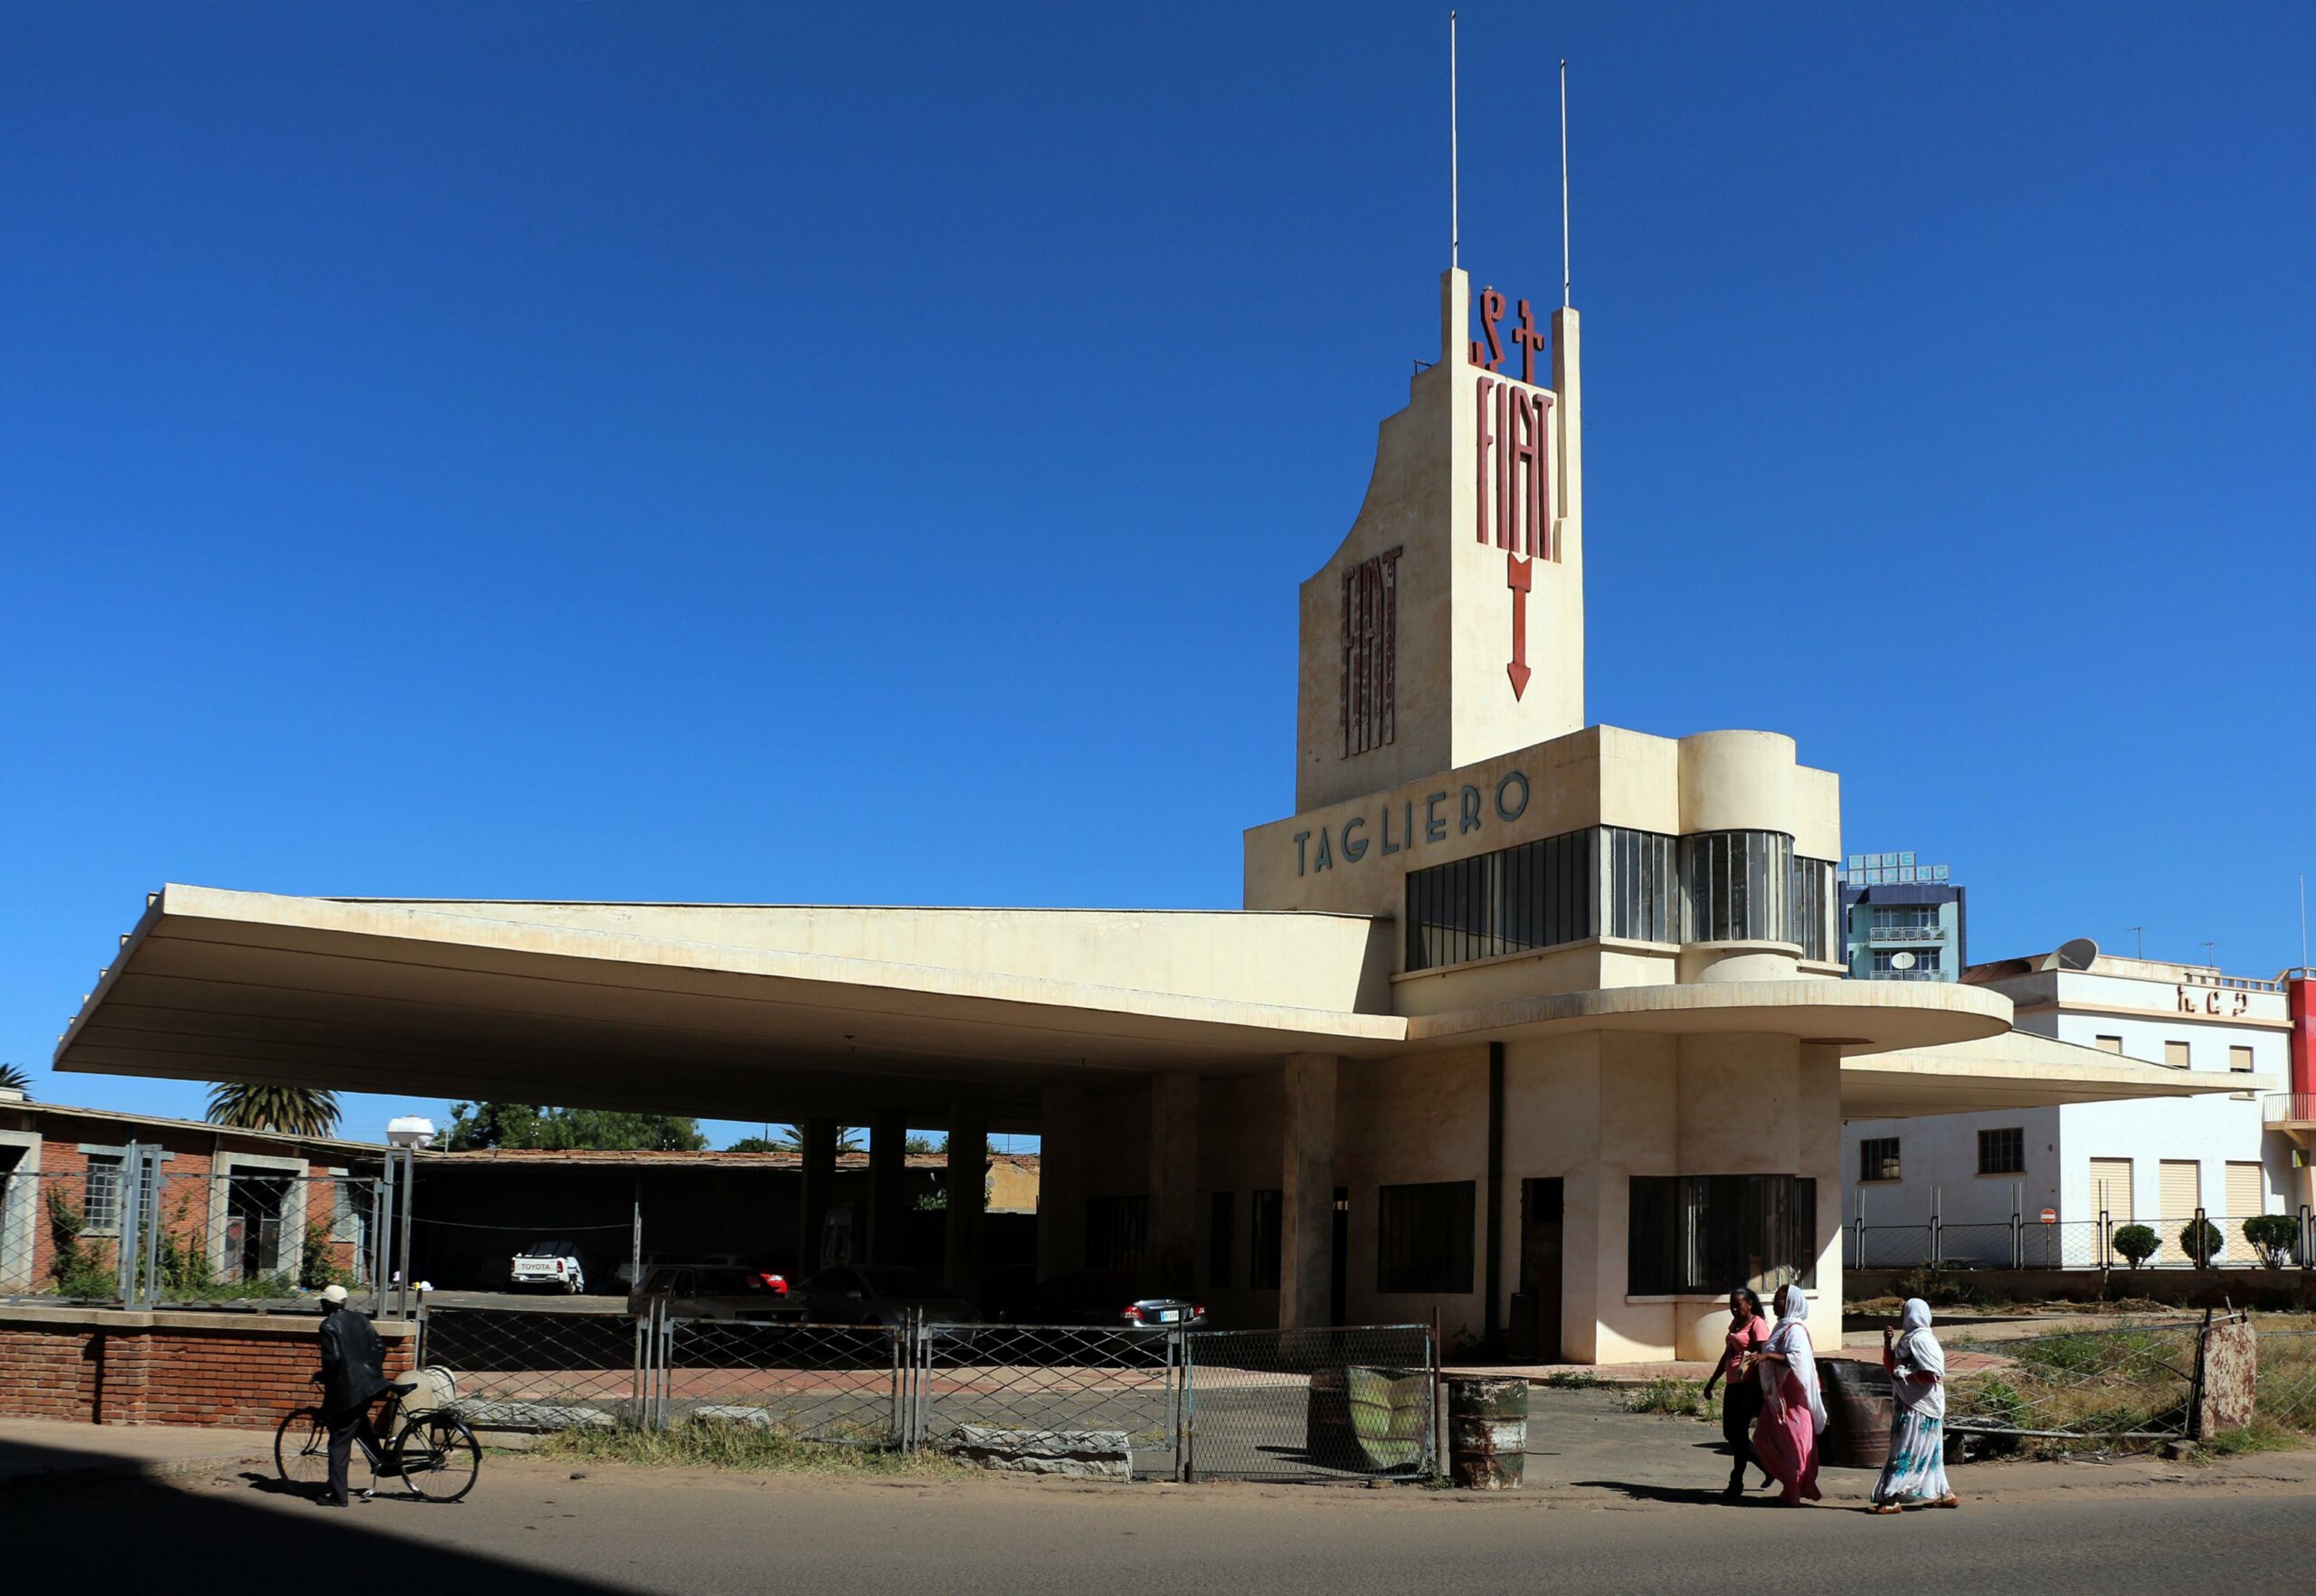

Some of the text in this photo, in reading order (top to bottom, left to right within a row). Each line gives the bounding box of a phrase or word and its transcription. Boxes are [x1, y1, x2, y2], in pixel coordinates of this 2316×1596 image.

[1468, 288, 1545, 385] ያት
[1476, 376, 1554, 561] FIAT
[1339, 546, 1403, 759] FIAT
[1294, 771, 1530, 878] TAGLIERO
[1850, 851, 1913, 868] BLUE
